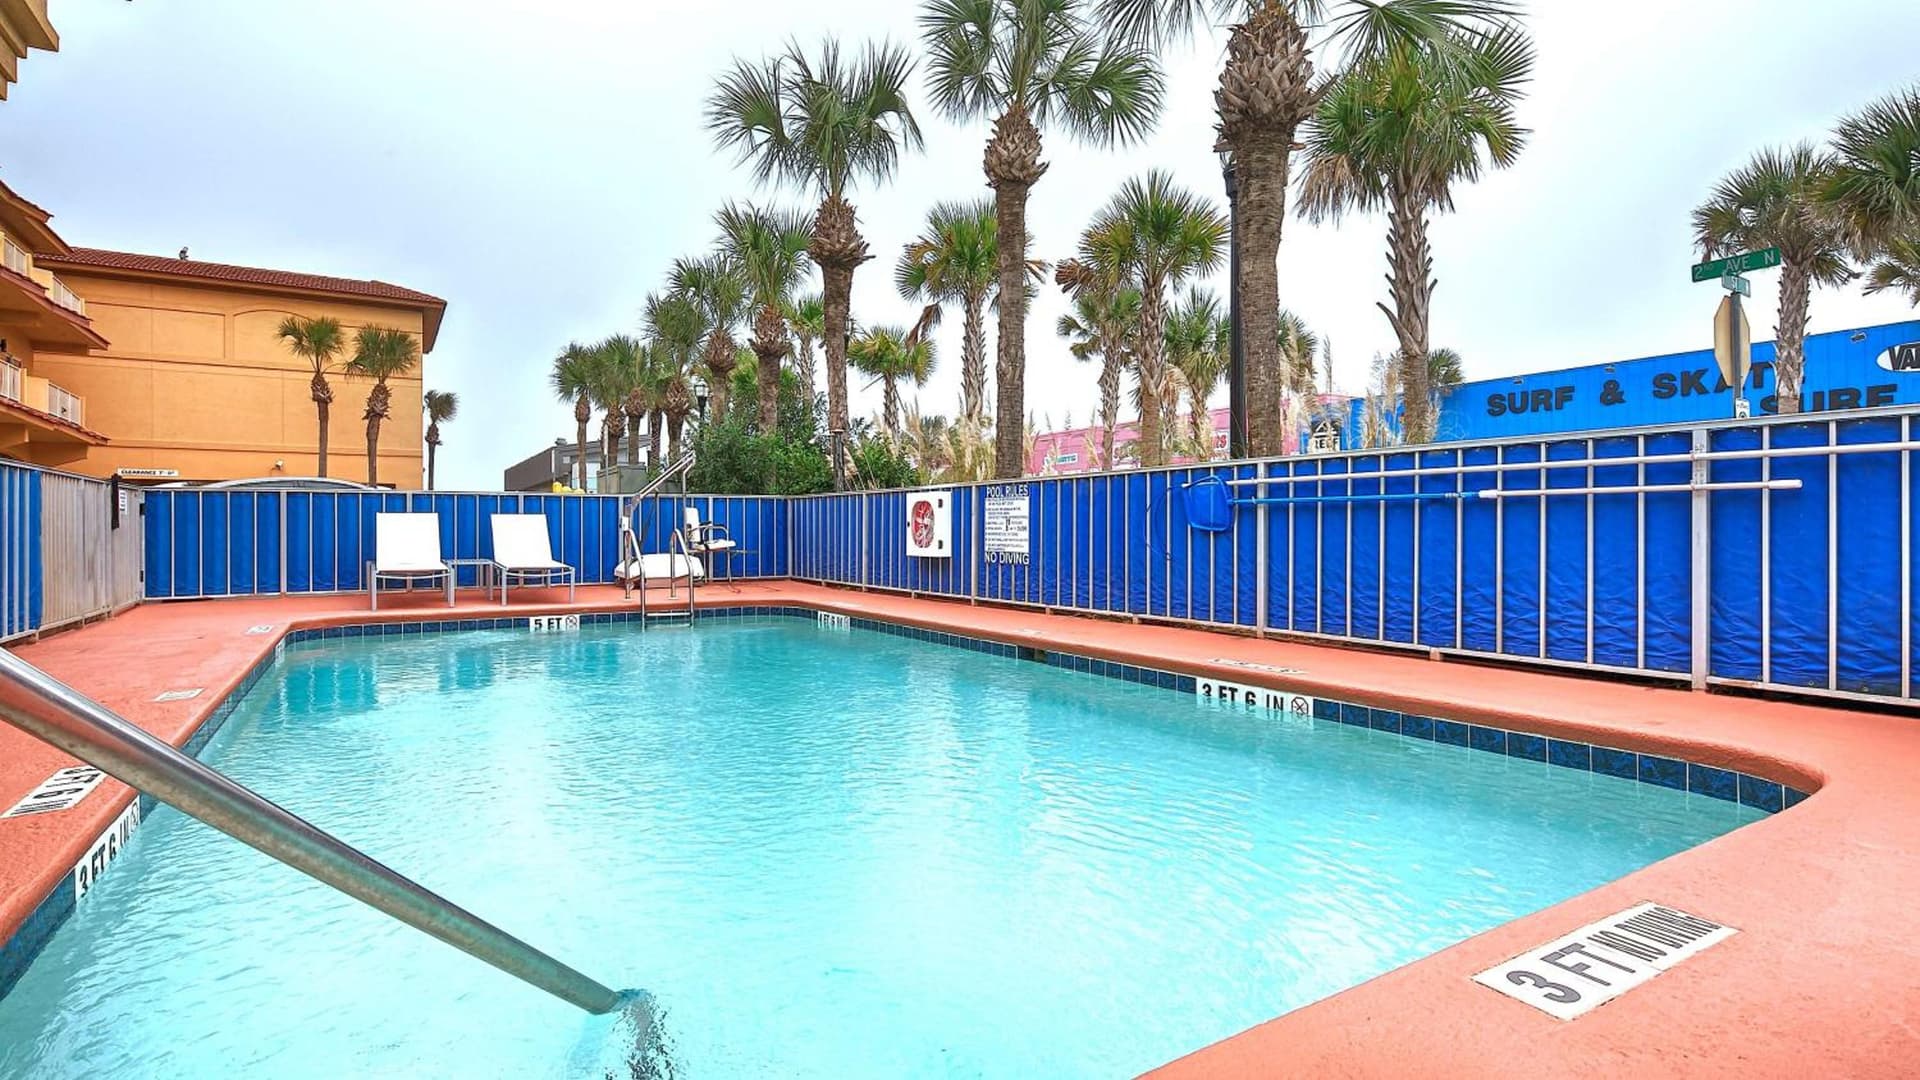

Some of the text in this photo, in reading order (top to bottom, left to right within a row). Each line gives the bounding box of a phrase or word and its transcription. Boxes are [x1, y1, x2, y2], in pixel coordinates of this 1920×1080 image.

[1725, 255, 1751, 271] AVE
[1764, 250, 1775, 265] N
[1887, 344, 1920, 371] VA
[1487, 361, 1805, 416] SURF & SKT
[986, 486, 1004, 498] POOL
[985, 552, 1030, 565] NO DIVING
[534, 617, 562, 632] 5 FT
[1202, 683, 1285, 711] 3 FT 6 IN
[79, 815, 130, 898] 3 FT 6 IN
[1506, 906, 1723, 1004] 3 FT NO DIVING
